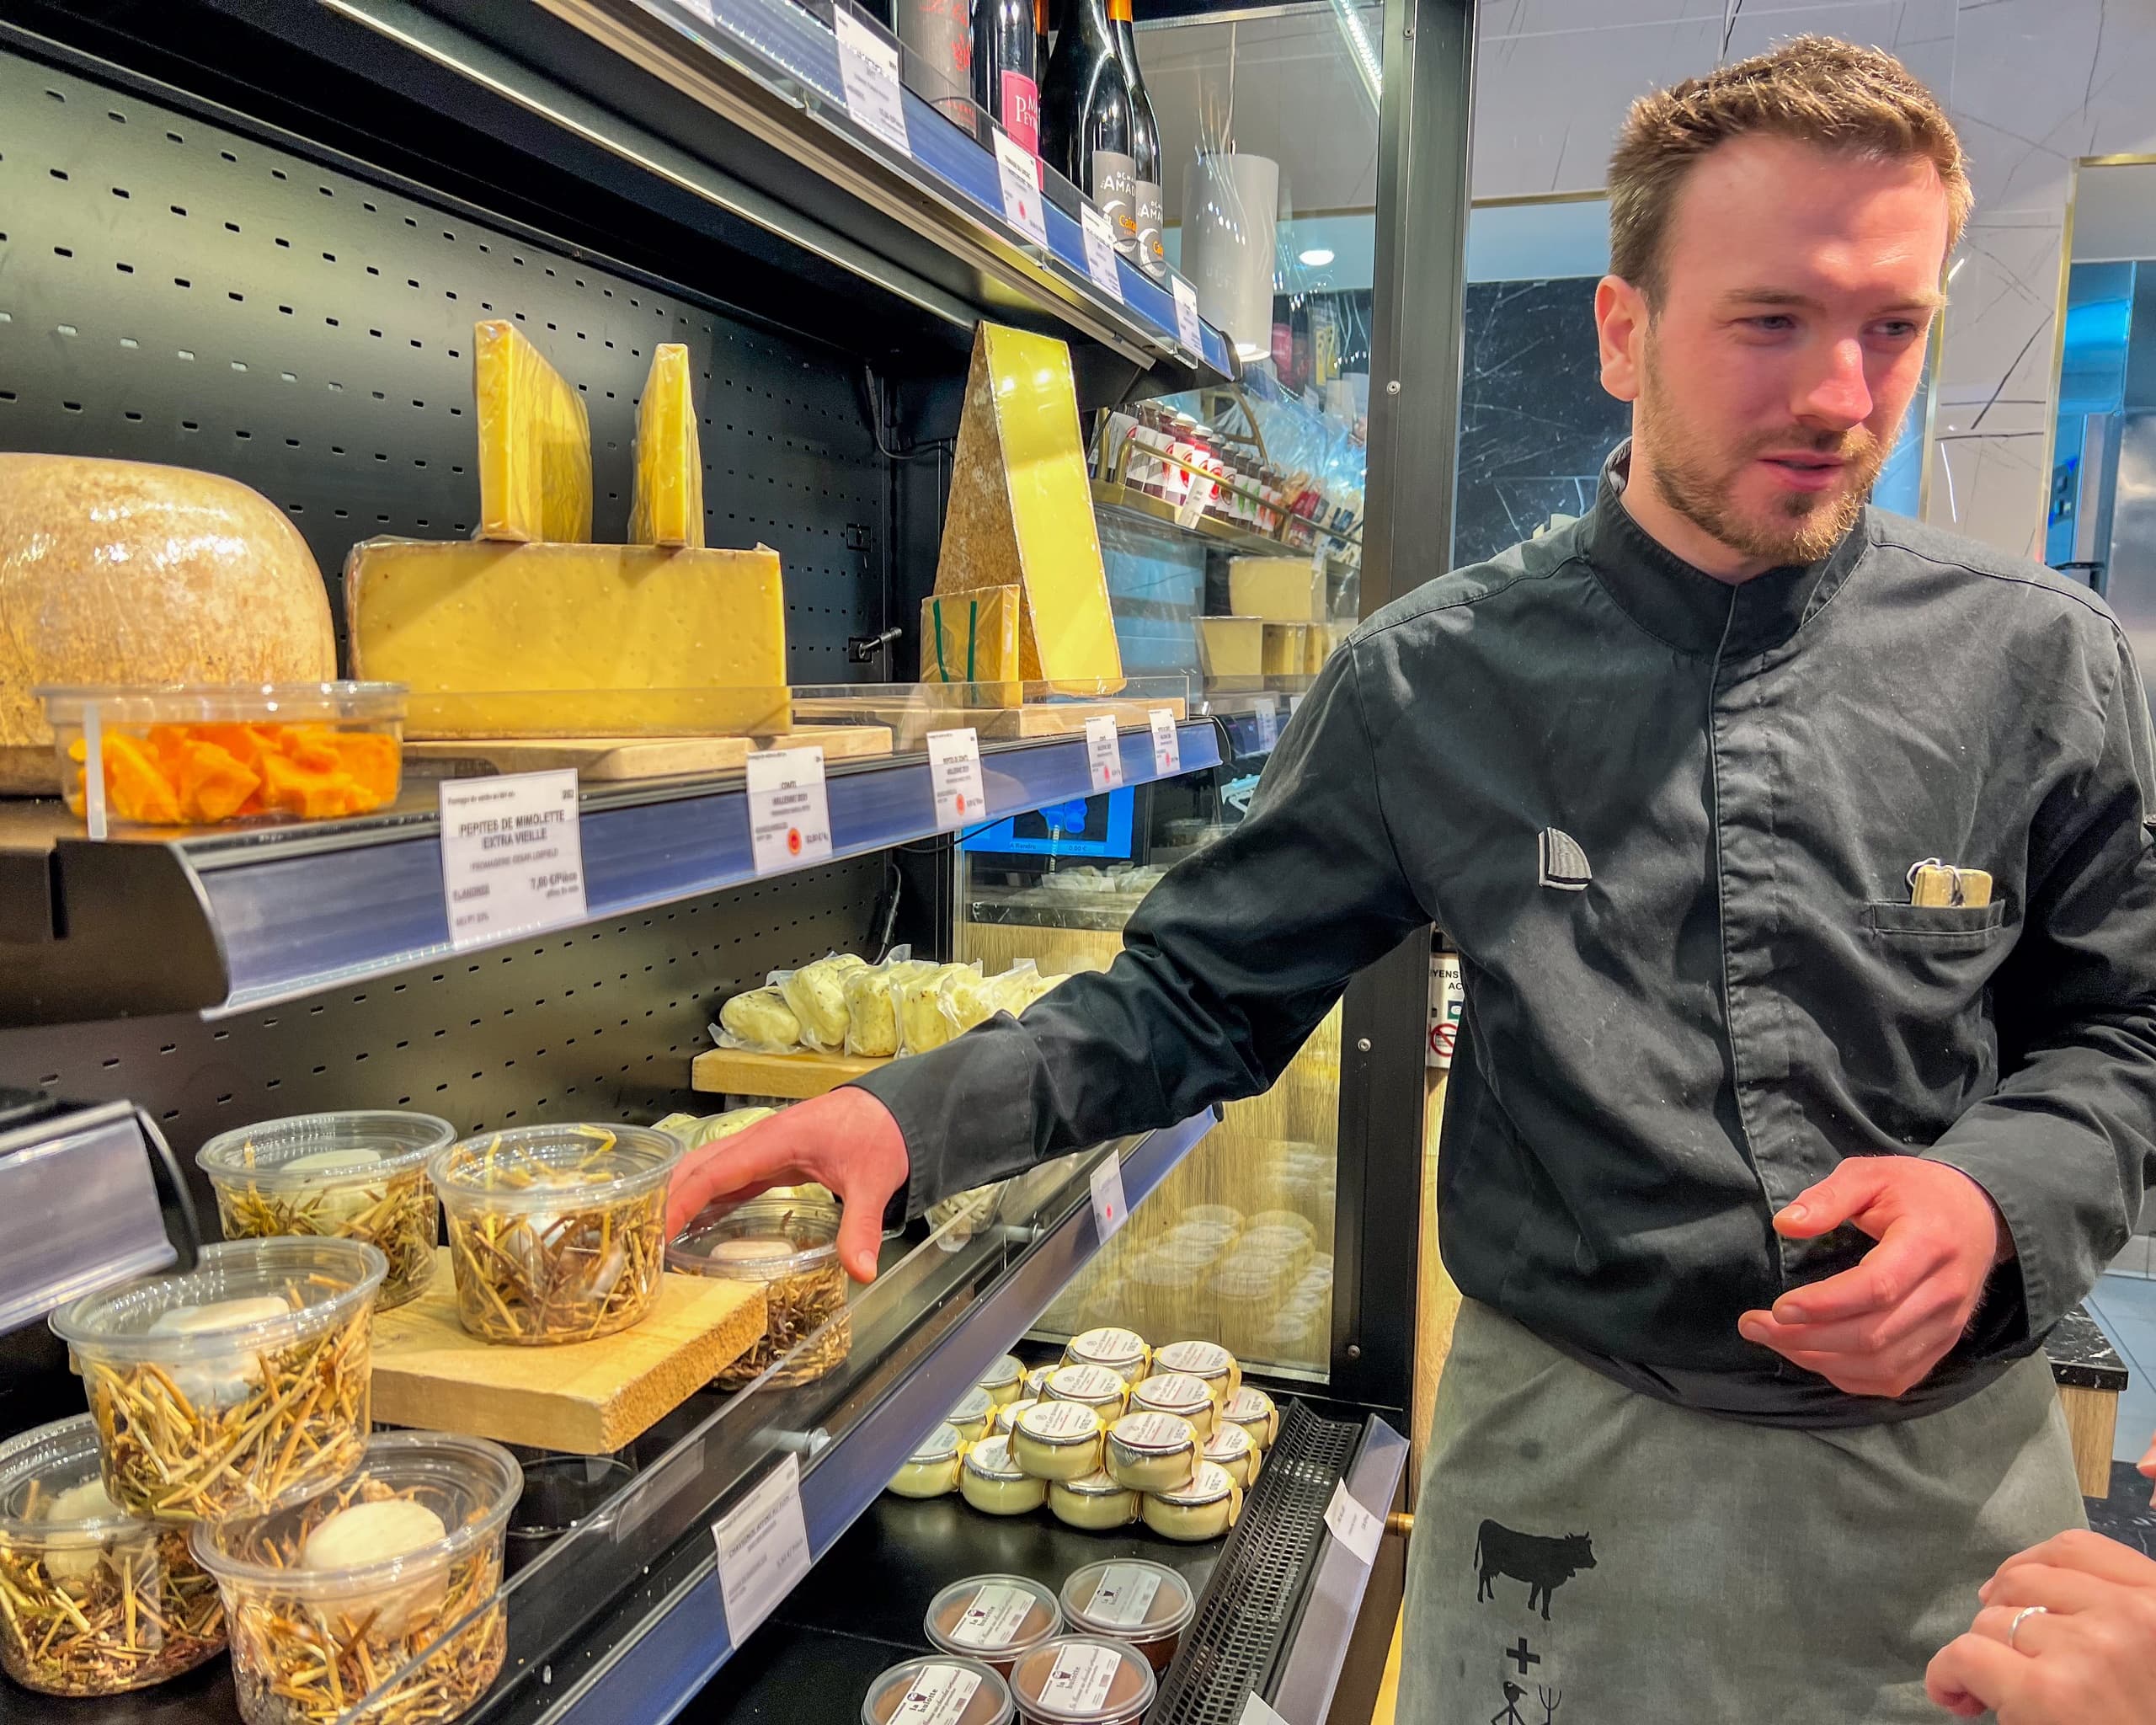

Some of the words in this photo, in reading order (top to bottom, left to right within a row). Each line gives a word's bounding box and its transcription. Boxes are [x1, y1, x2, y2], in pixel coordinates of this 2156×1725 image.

[460, 820, 499, 836] PEPITES
[501, 817, 513, 830] DE
[515, 809, 565, 828] MIMOLETTE
[483, 834, 514, 850] EXTRA
[515, 828, 547, 843] VIEILLE
[917, 1688, 938, 1713] hulotte
